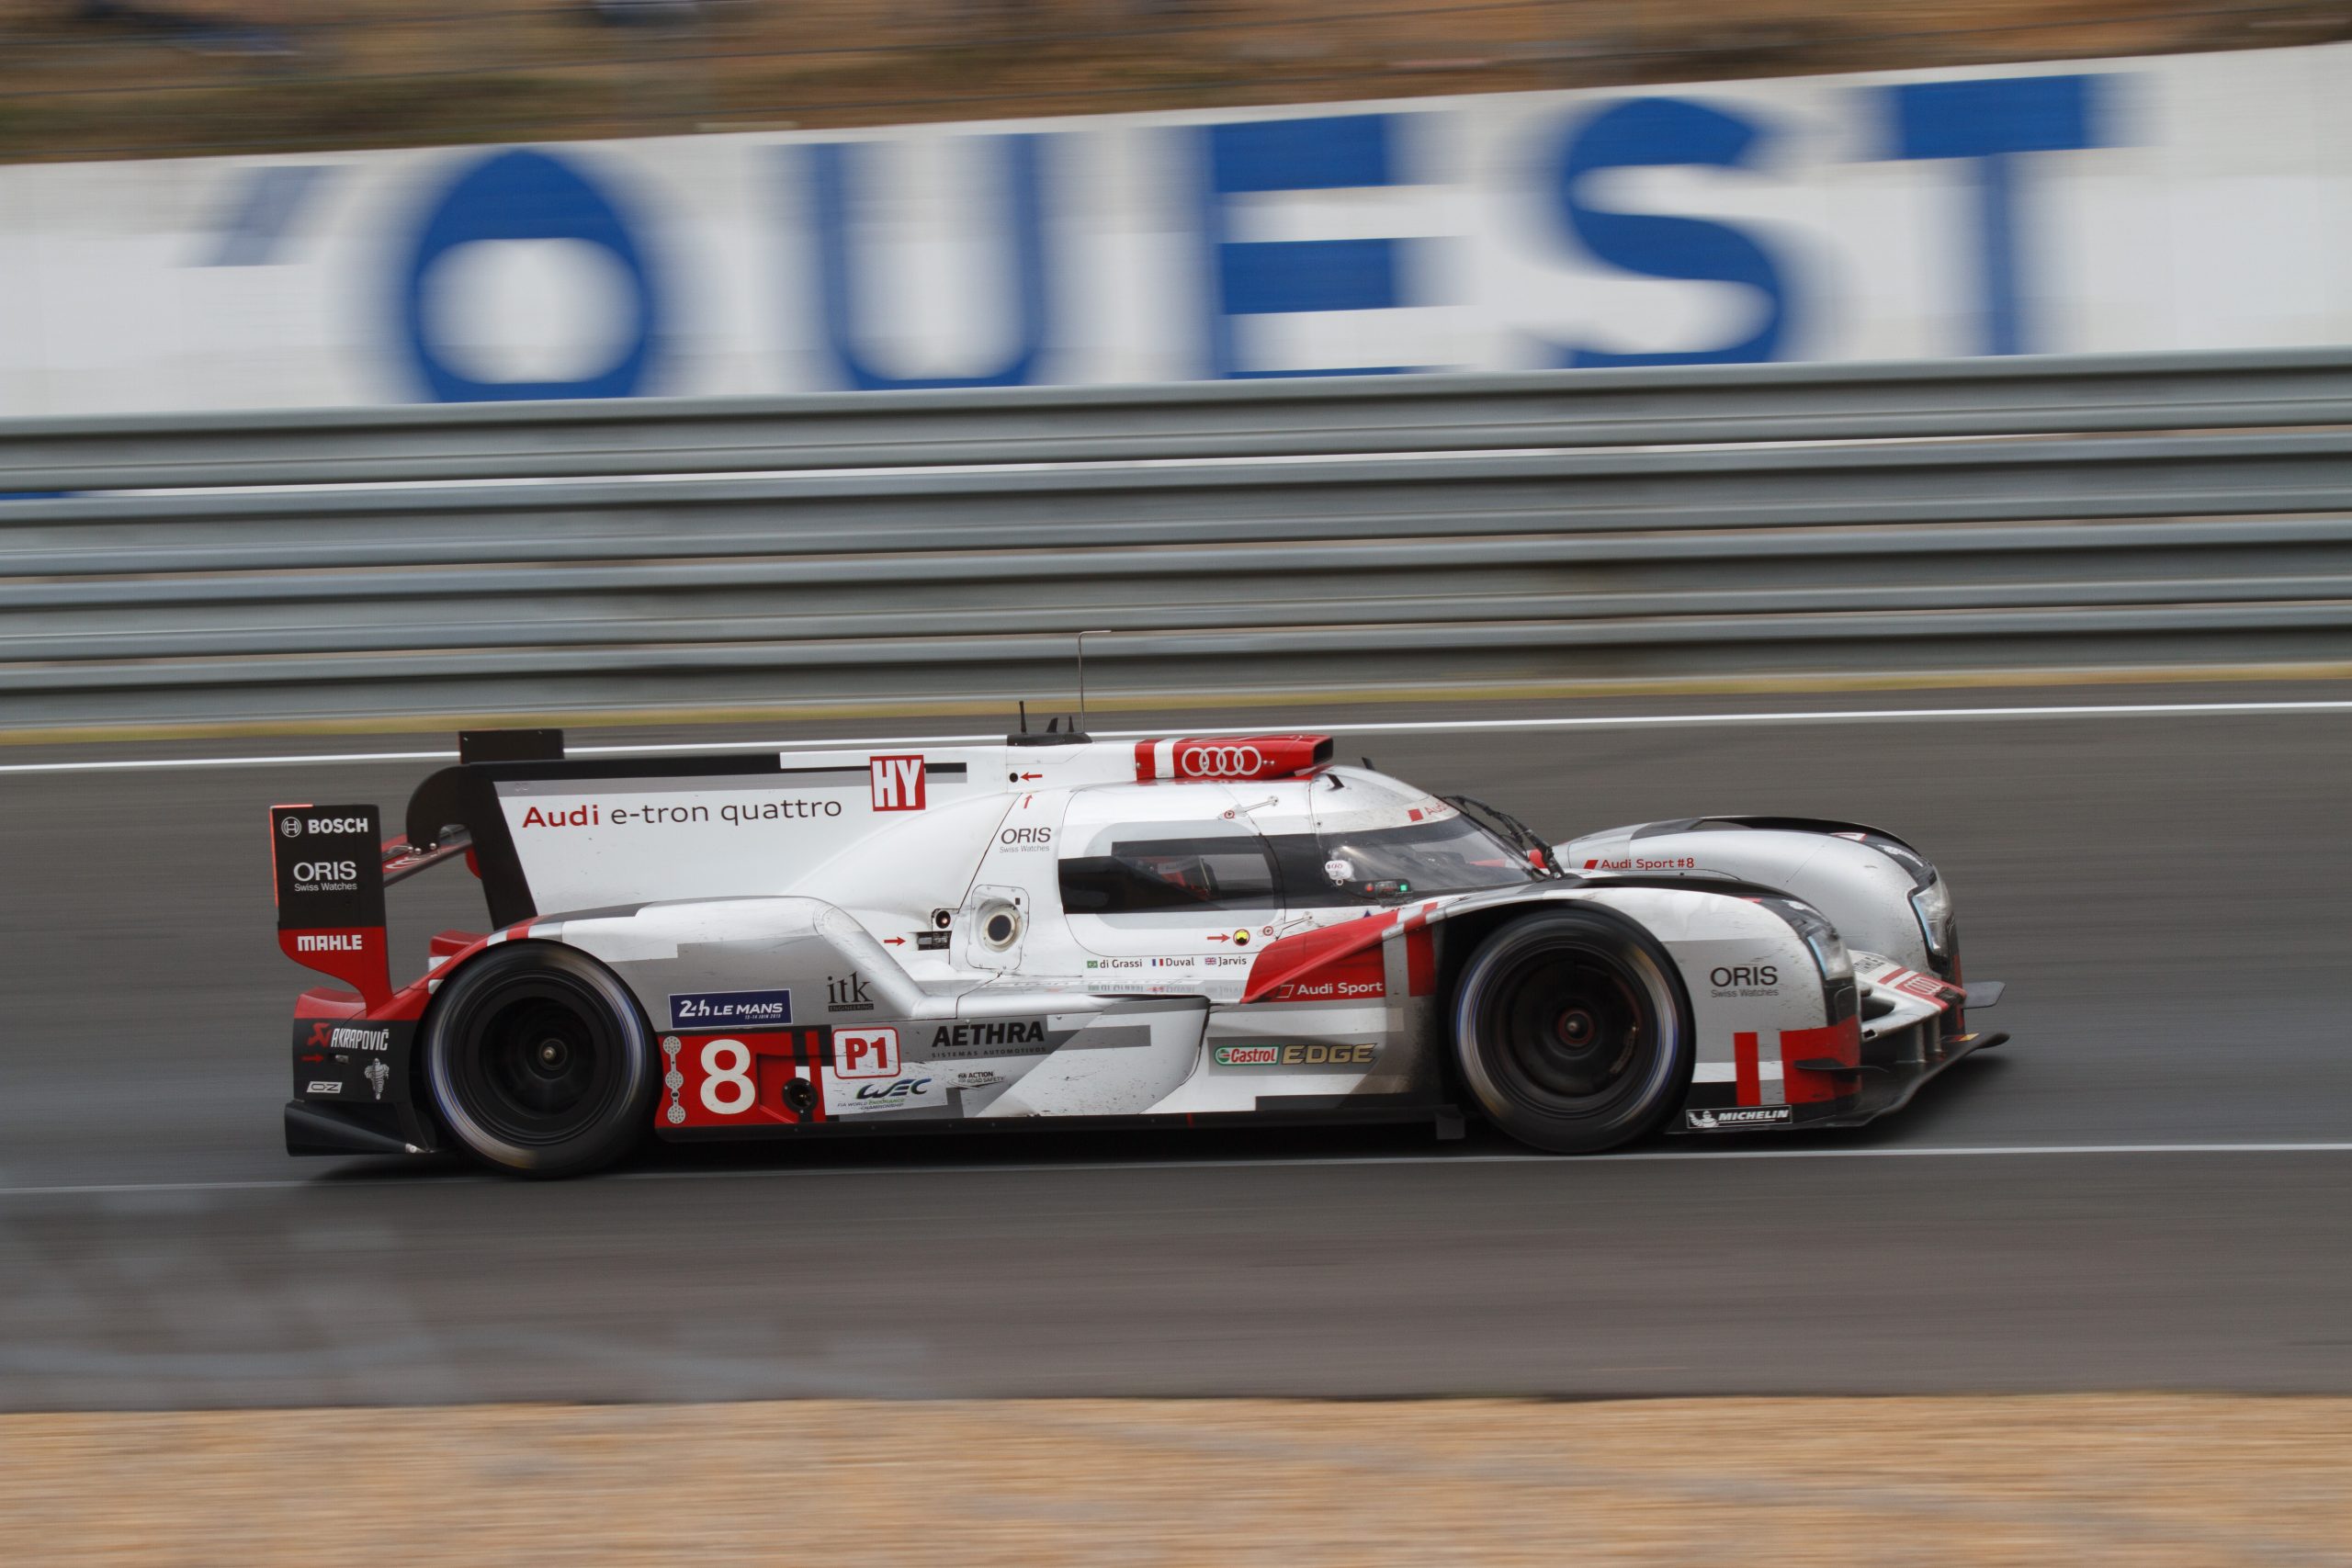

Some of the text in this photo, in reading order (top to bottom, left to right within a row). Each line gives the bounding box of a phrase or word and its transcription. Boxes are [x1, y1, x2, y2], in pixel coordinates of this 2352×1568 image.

[871, 759, 922, 807] HY
[523, 798, 842, 828] Audi e-tron quattro
[308, 818, 368, 834] BOSCH
[1001, 827, 1051, 844] ORIS
[1021, 844, 1050, 852] Watches
[293, 861, 357, 882] ORIS
[1600, 857, 1695, 871] Audi Sport #8
[294, 882, 357, 892] Swiss Watches
[297, 934, 363, 952] MAHLE
[1100, 958, 1143, 969] di Grassi
[1166, 957, 1194, 967] Duval
[1218, 956, 1248, 966] Jarvis
[1710, 965, 1779, 987] ORIS
[827, 971, 874, 1004] itk
[1296, 982, 1384, 996] Audi Sport
[1711, 988, 1780, 998] Swiss Watches
[713, 1005, 734, 1016] LE
[736, 1003, 784, 1015] MANS
[932, 1021, 1045, 1047] AETHRA
[844, 1036, 888, 1071] P1
[932, 1047, 1046, 1058] SISTEMAS AUTOMOTIVOS
[1230, 1043, 1377, 1066] Castrol EDGE
[700, 1038, 756, 1115] 8
[968, 1071, 994, 1079] ACTION
[855, 1077, 933, 1100] WEC
[1717, 1110, 1789, 1121] MICHELIN
